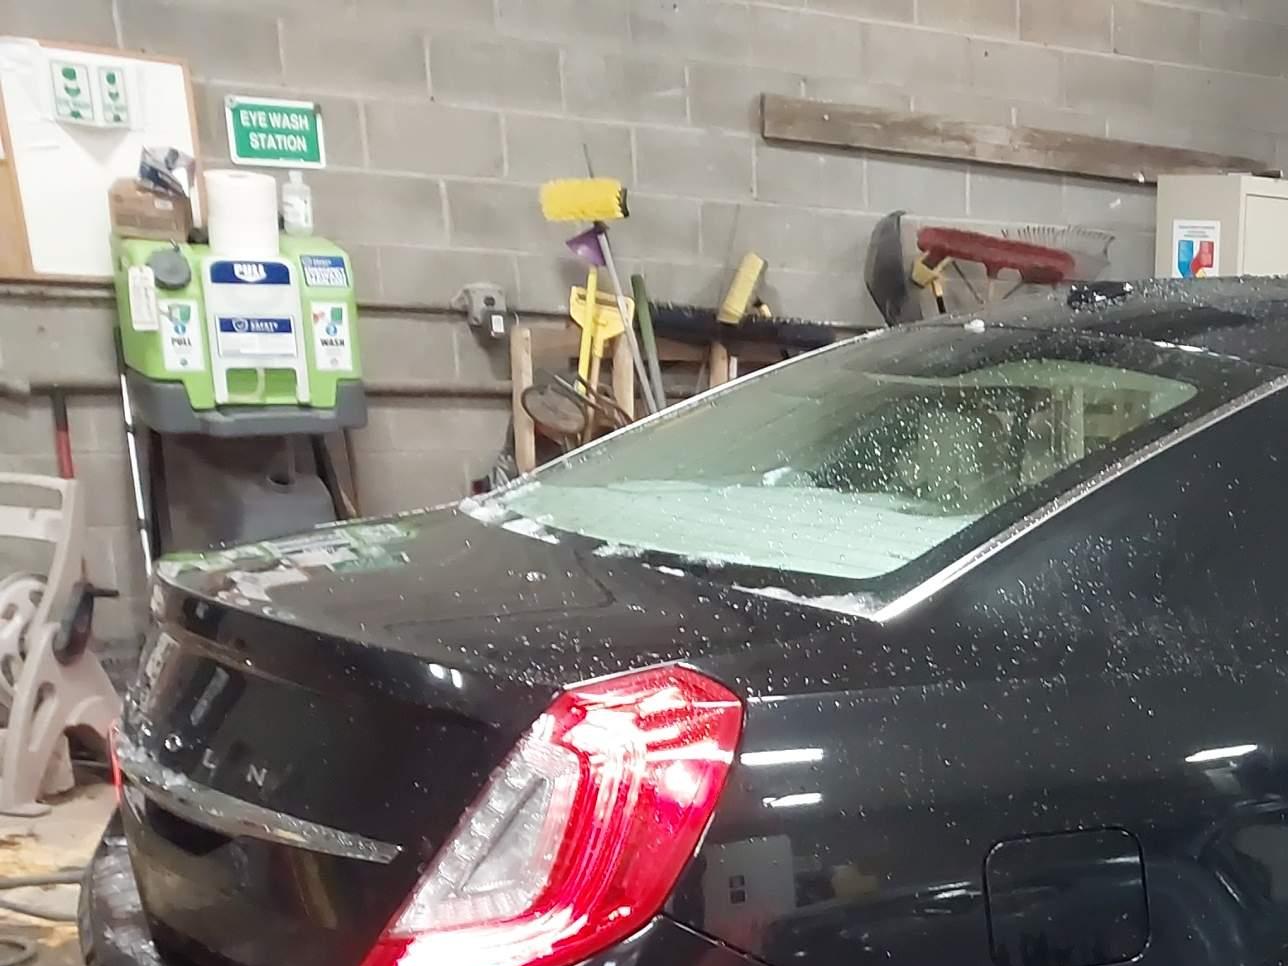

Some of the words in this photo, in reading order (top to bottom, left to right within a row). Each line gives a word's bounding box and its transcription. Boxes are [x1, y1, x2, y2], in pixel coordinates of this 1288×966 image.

[240, 109, 267, 128] EYE
[268, 111, 310, 131] WASH
[249, 131, 307, 152] STATION
[319, 337, 345, 347] WASH
